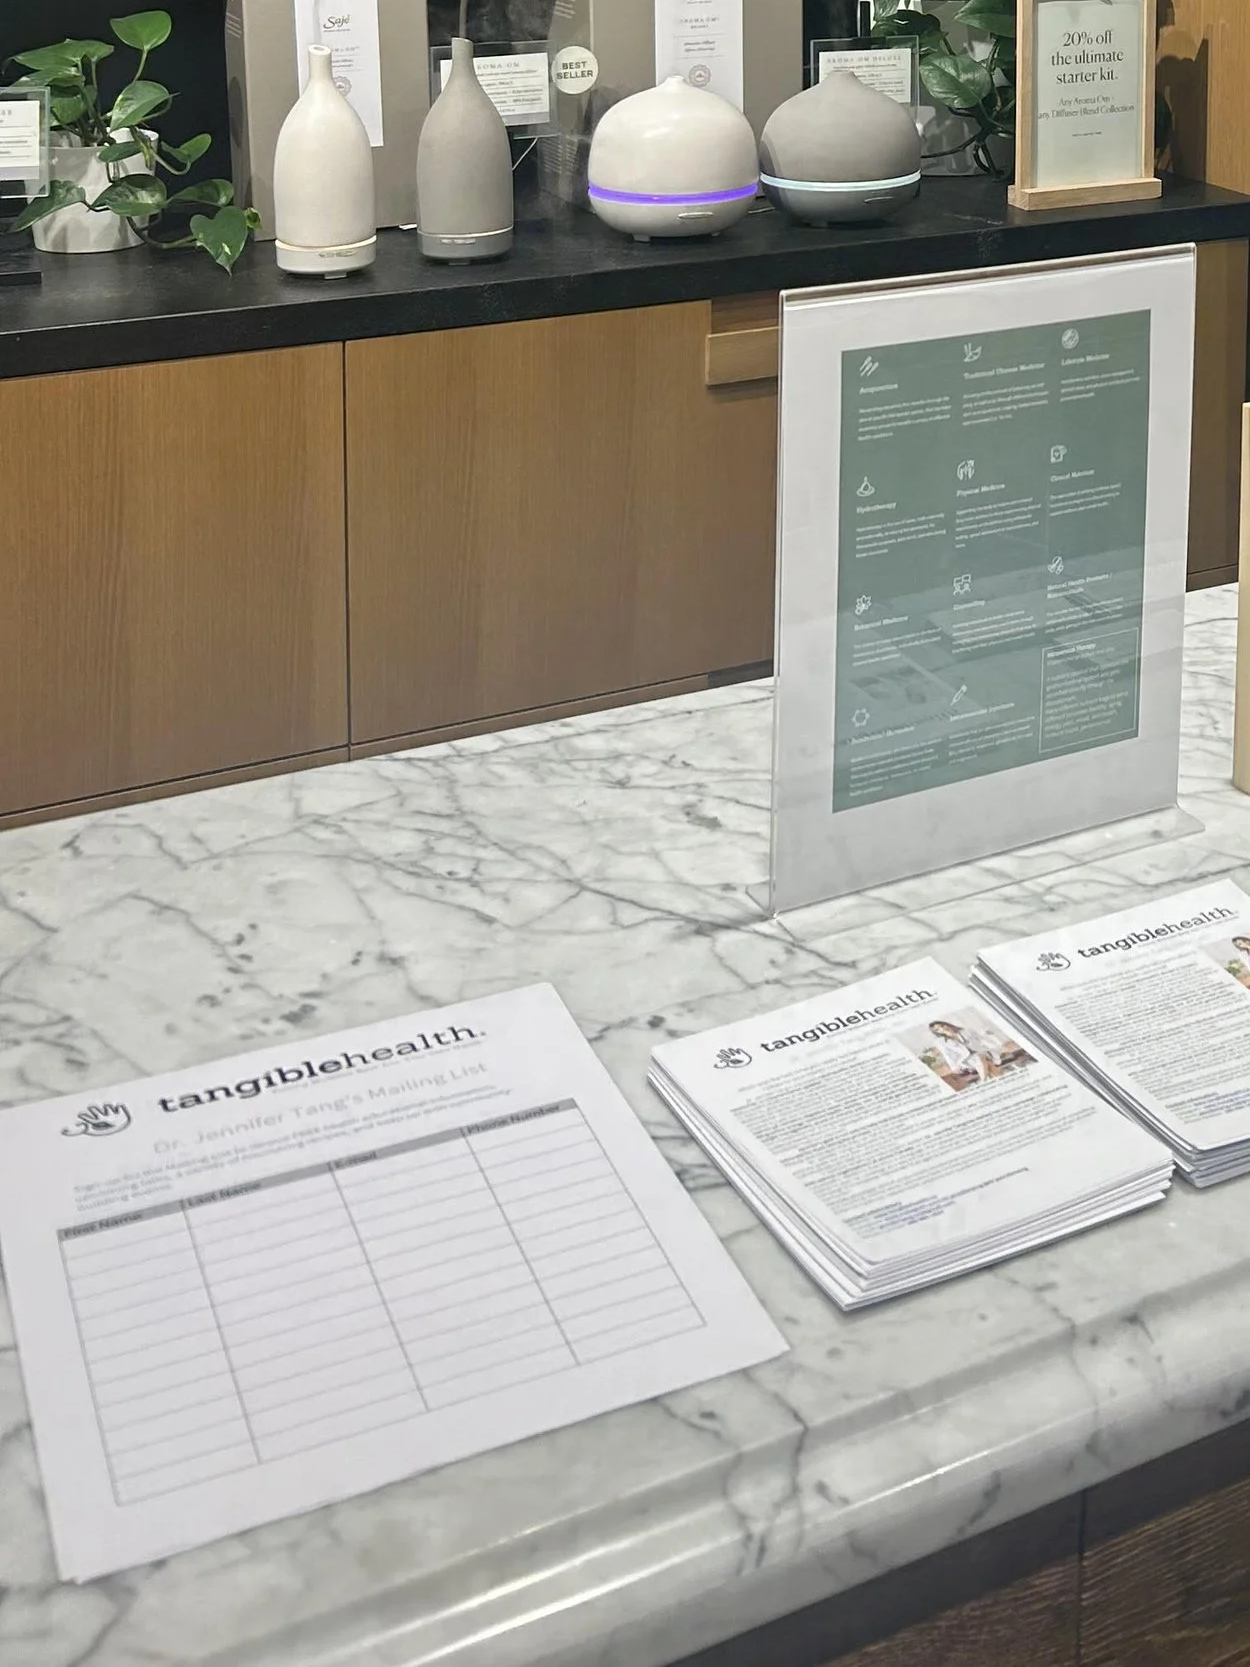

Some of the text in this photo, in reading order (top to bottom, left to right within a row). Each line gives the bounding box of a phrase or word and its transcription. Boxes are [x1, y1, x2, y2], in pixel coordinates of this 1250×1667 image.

[1063, 29, 1113, 47] 20% off
[562, 60, 588, 70] BEST
[1051, 49, 1125, 67] the ultimate
[556, 69, 594, 80] SELLER
[1055, 66, 1119, 85] starter kit.
[158, 1025, 488, 1113] tangiblehealth.
[196, 1112, 285, 1145] Jennifer
[290, 1091, 365, 1118] Tang's
[367, 1072, 449, 1101] Mailing
[449, 1060, 488, 1081] List
[219, 1182, 262, 1200] Name
[99, 1211, 143, 1231] Name
